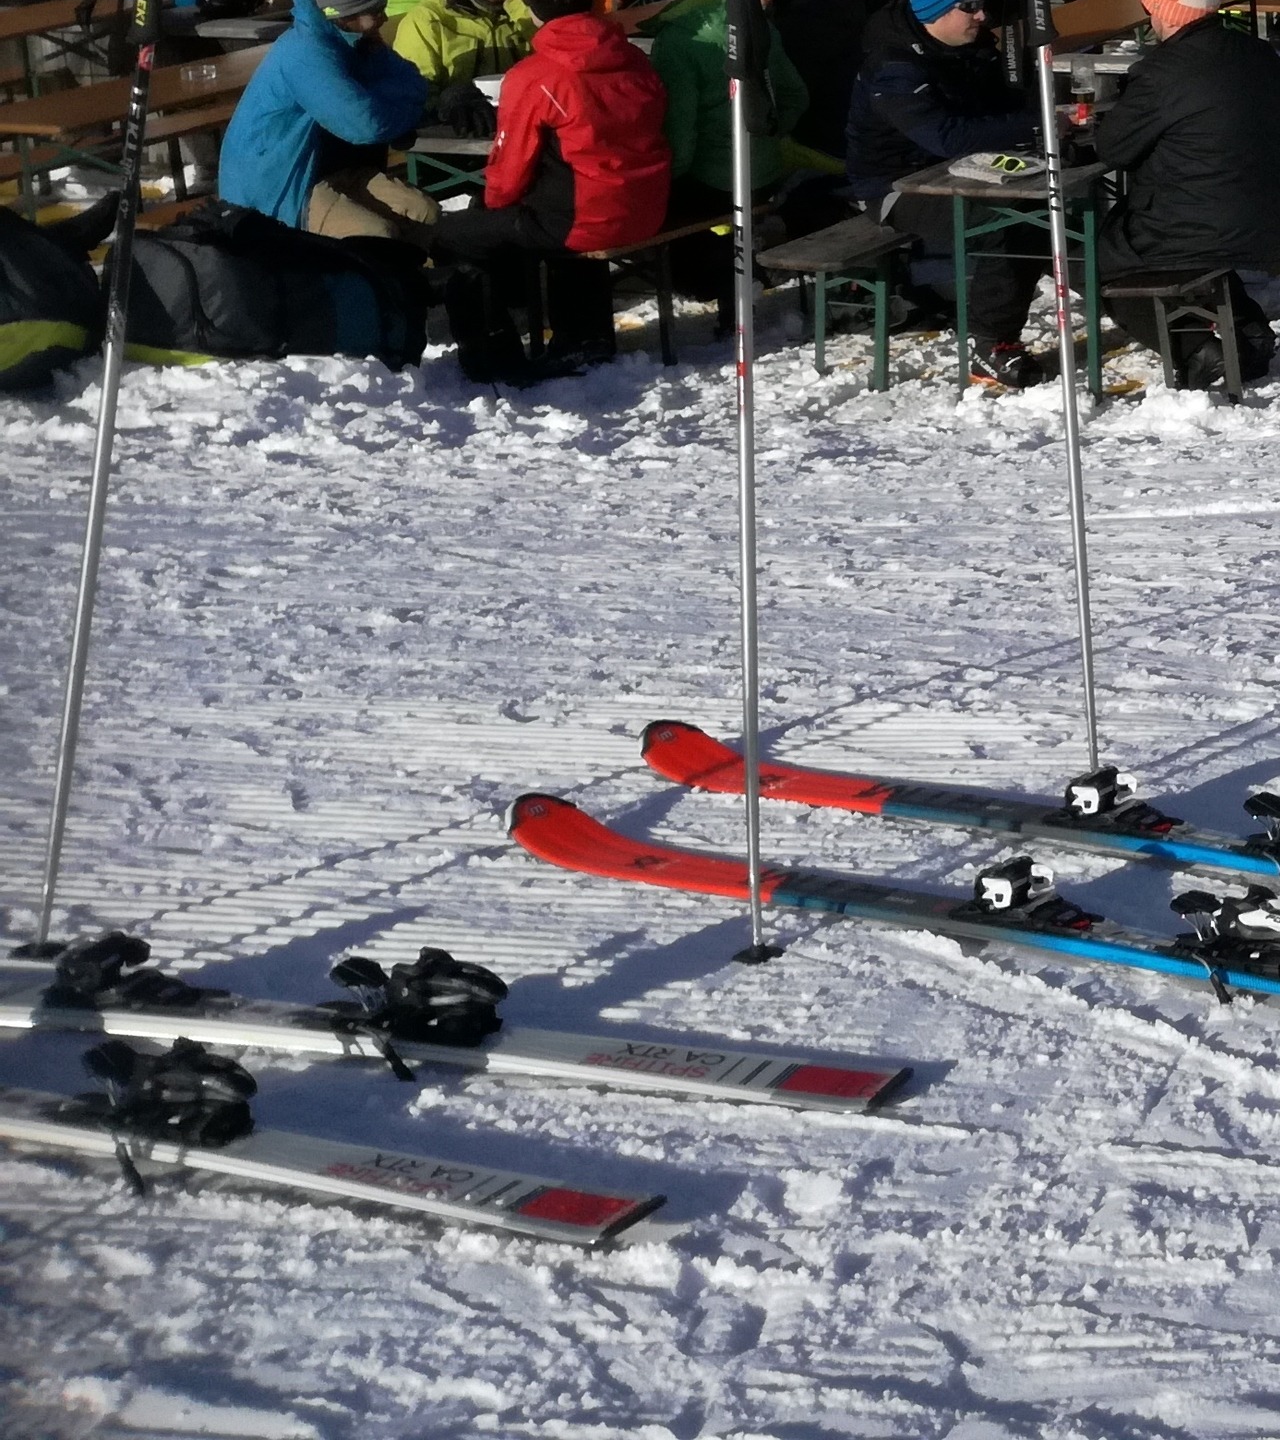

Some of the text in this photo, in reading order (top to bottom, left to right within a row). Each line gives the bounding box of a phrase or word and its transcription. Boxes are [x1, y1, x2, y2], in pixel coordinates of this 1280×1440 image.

[1034, 0, 1046, 31] LEKI
[728, 23, 738, 60] LEKI
[586, 1052, 711, 1079] SPITFIRE
[615, 1042, 676, 1060] RTX
